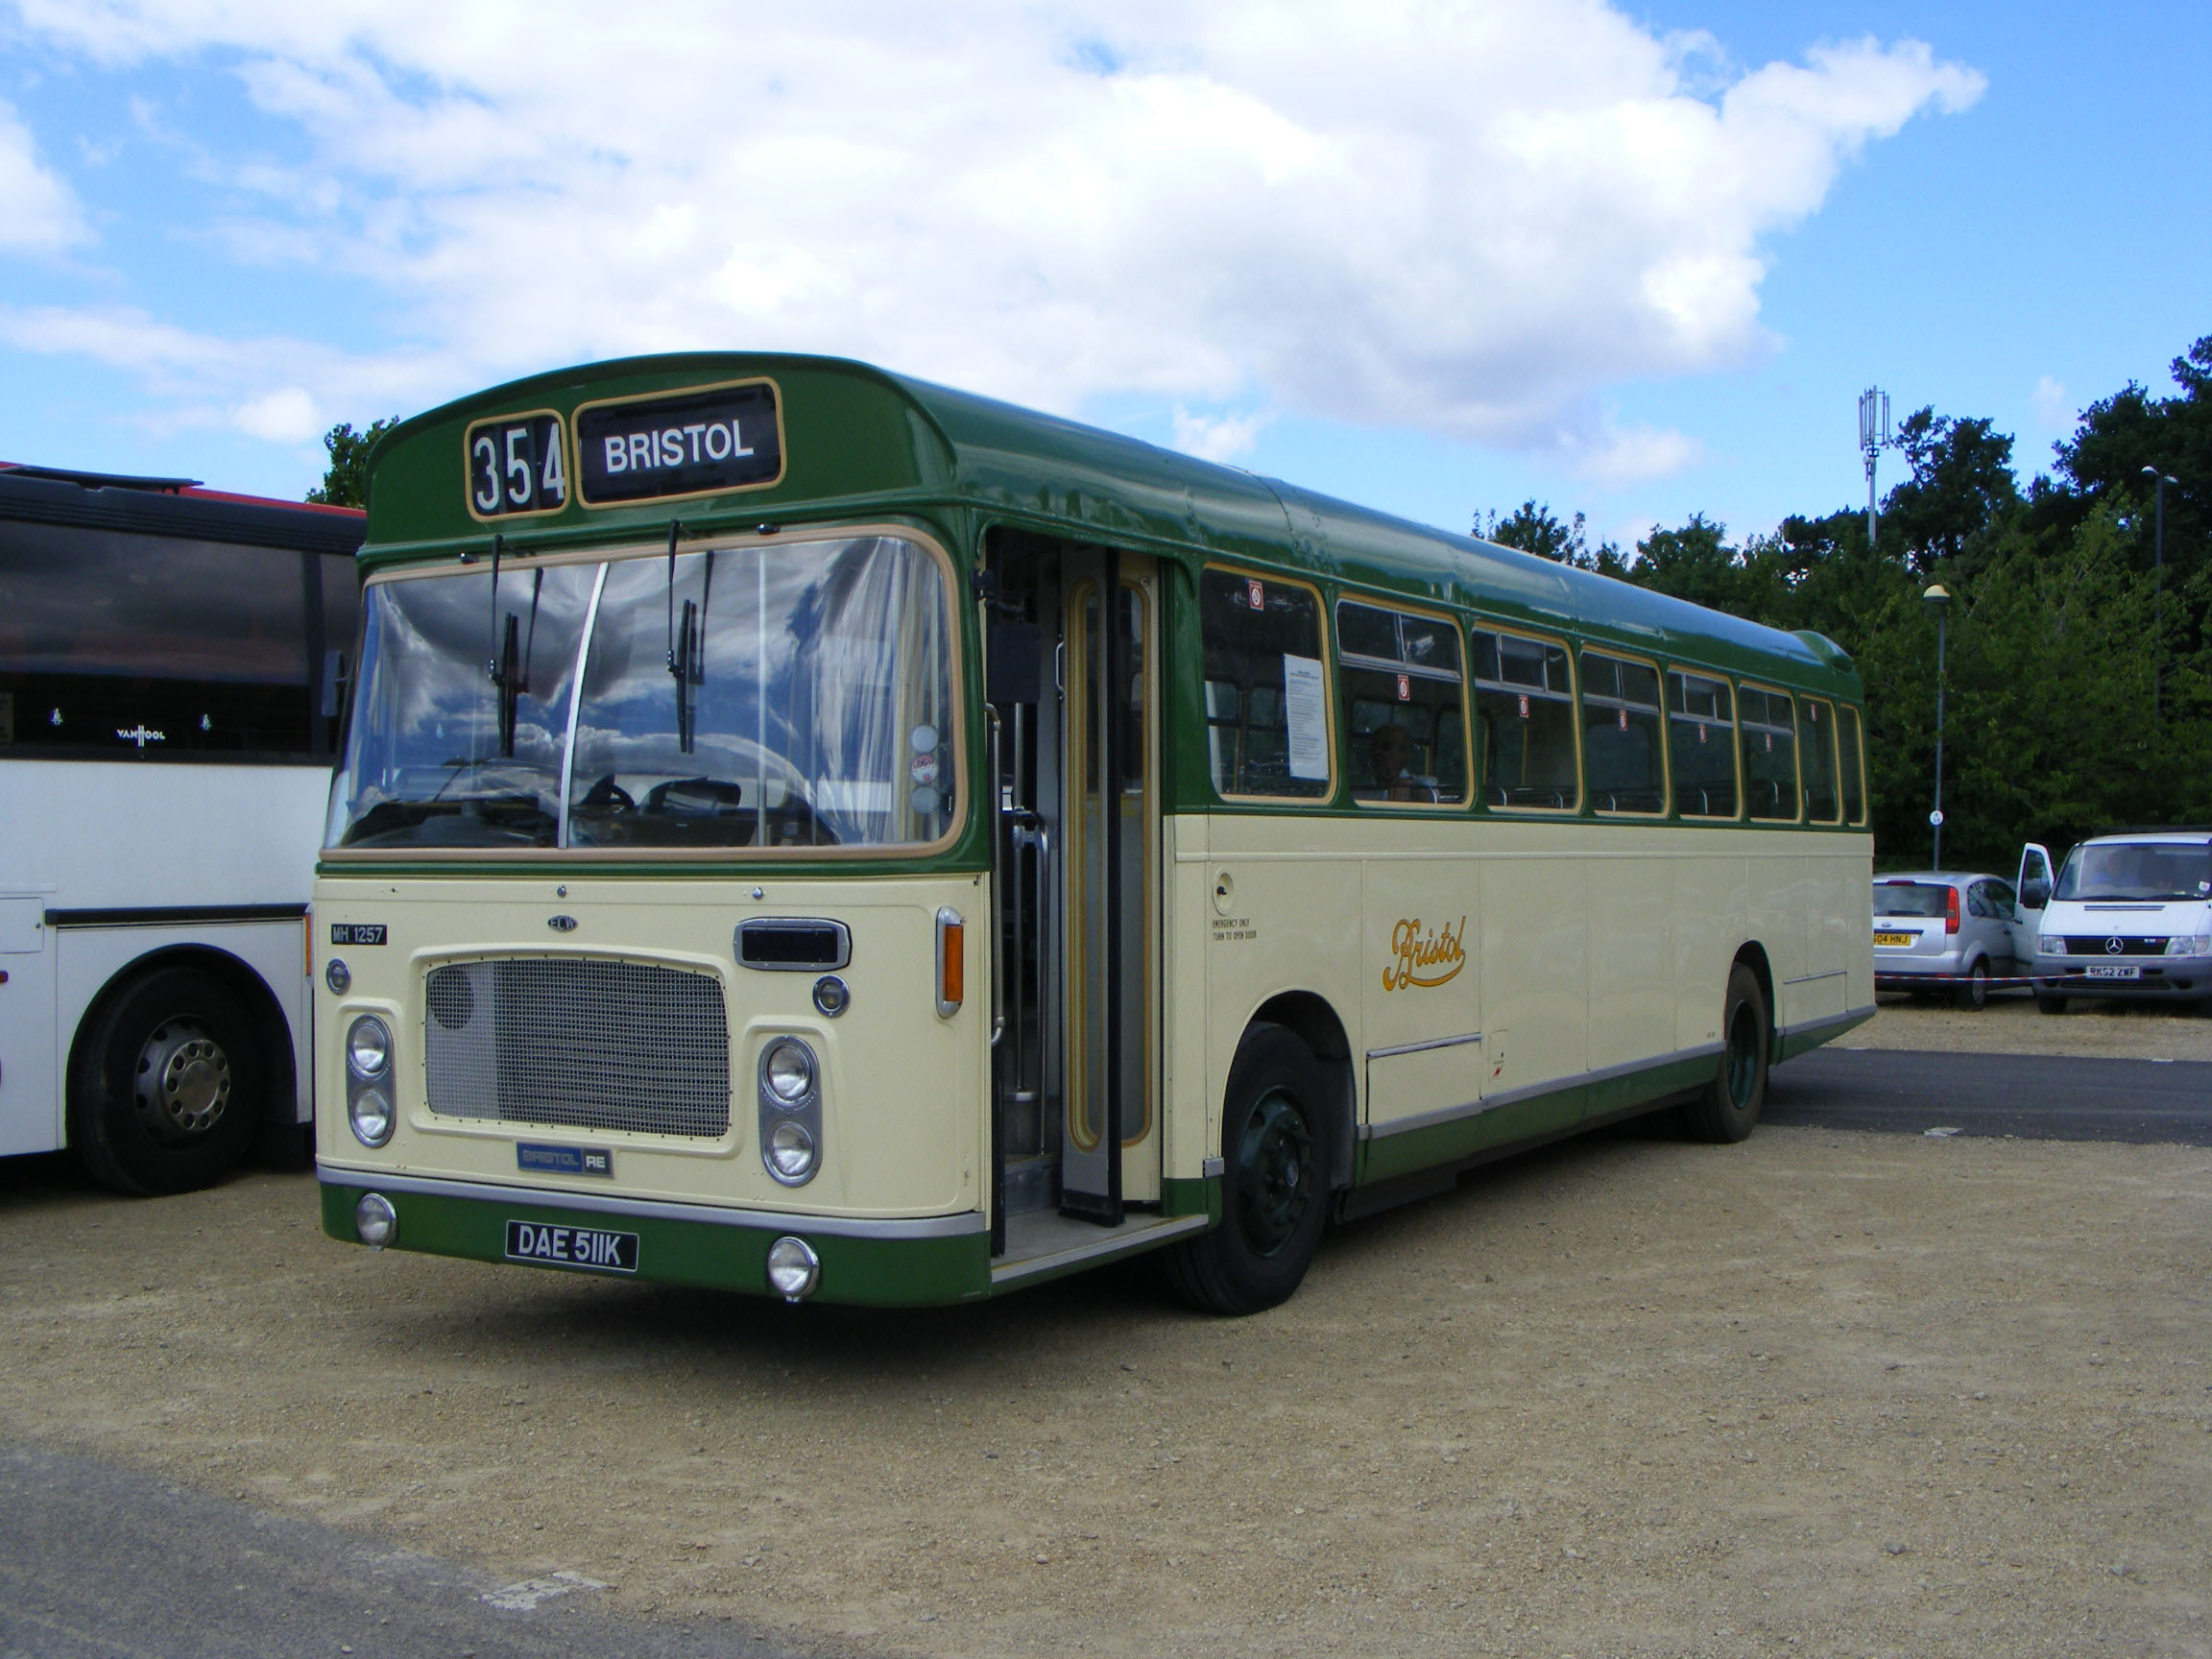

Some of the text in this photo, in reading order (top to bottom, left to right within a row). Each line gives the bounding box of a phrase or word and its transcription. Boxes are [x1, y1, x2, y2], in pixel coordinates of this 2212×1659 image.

[474, 420, 755, 510] 354 BRISTOL
[1213, 918, 1250, 929] EMERGENCY ONLY
[332, 926, 384, 943] MH 1257
[1213, 929, 1258, 941] TURN TO OPEN DOOR
[1382, 915, 1466, 992] Bristol
[521, 1149, 606, 1168] BRISTOL RE
[518, 1224, 622, 1265] DAE 511K
